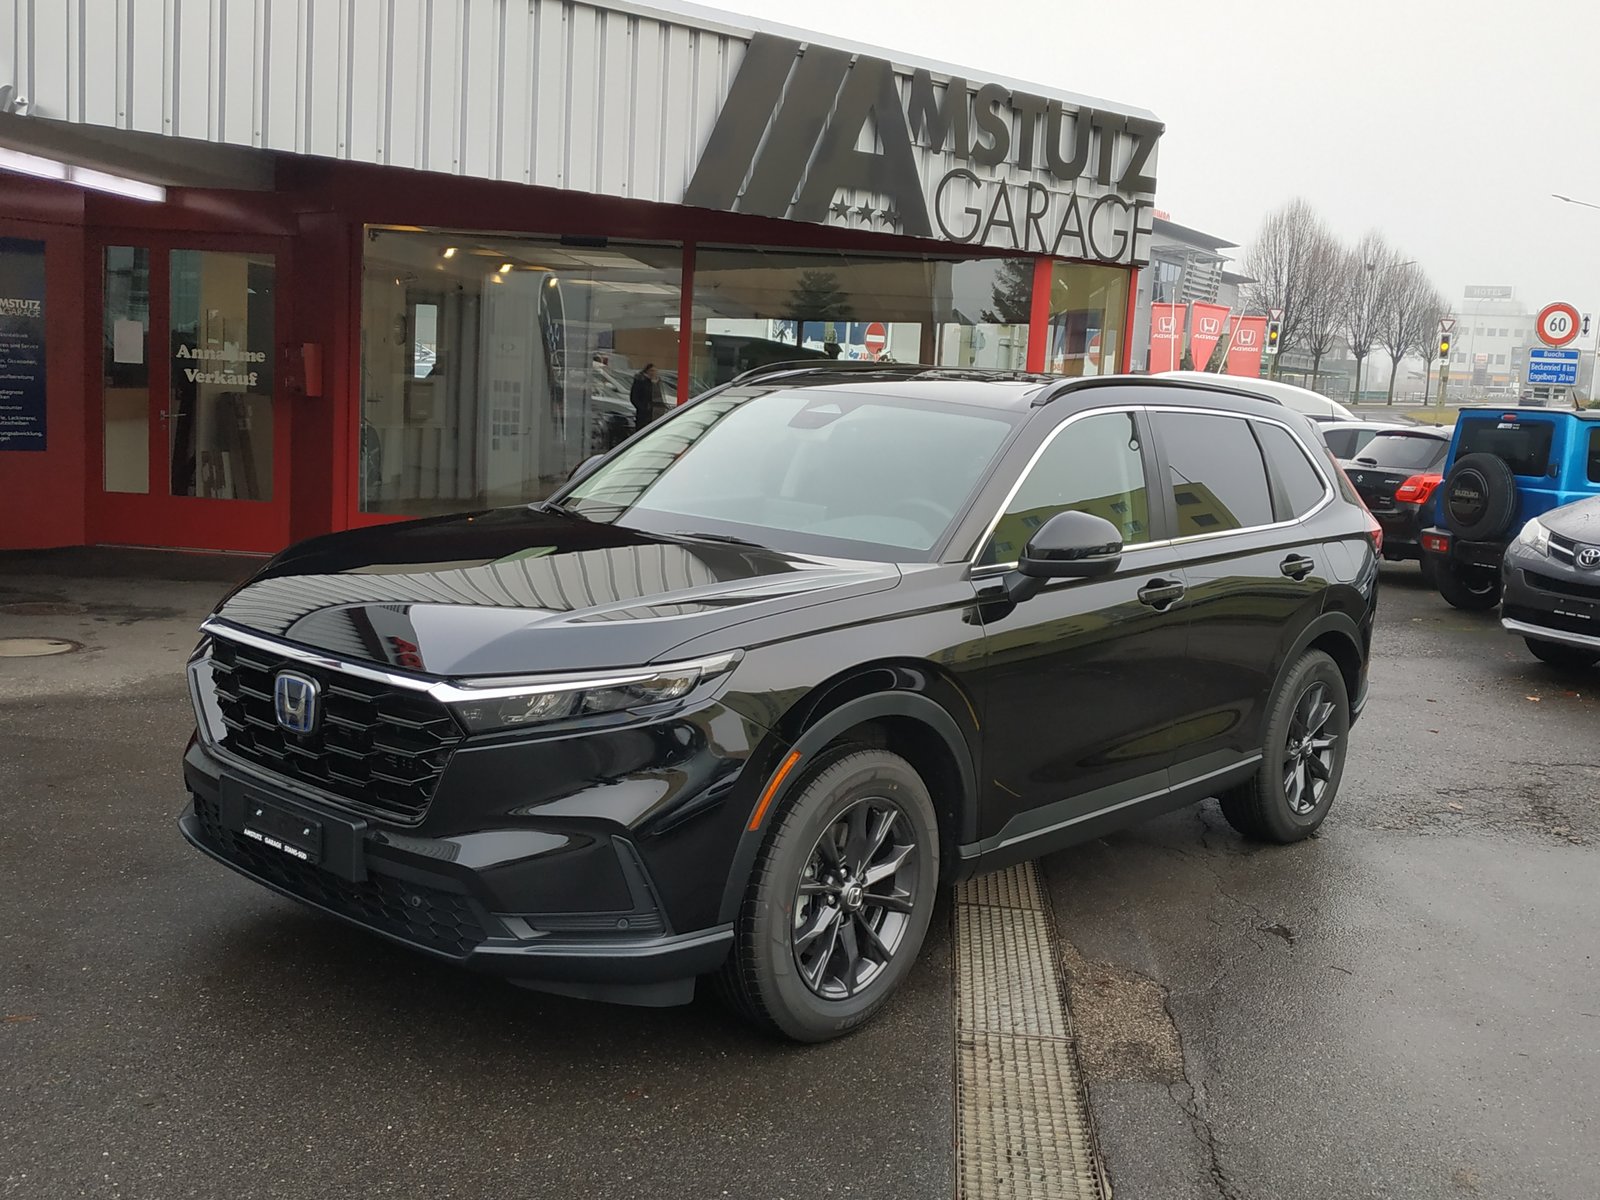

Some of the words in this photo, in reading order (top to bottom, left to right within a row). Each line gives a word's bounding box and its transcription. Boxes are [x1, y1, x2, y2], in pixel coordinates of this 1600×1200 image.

[787, 53, 1165, 239] AMSTUTZ
[935, 168, 1154, 266] GARAGE
[1474, 288, 1502, 296] HOTEL
[0, 298, 41, 309] MSTUTZ
[1549, 317, 1567, 332] 60
[176, 344, 266, 362] Anname
[1544, 350, 1565, 358] Buochs
[1531, 362, 1561, 371] Beckenried
[184, 368, 258, 386] Verkauf
[1530, 372, 1557, 382] Engelberg
